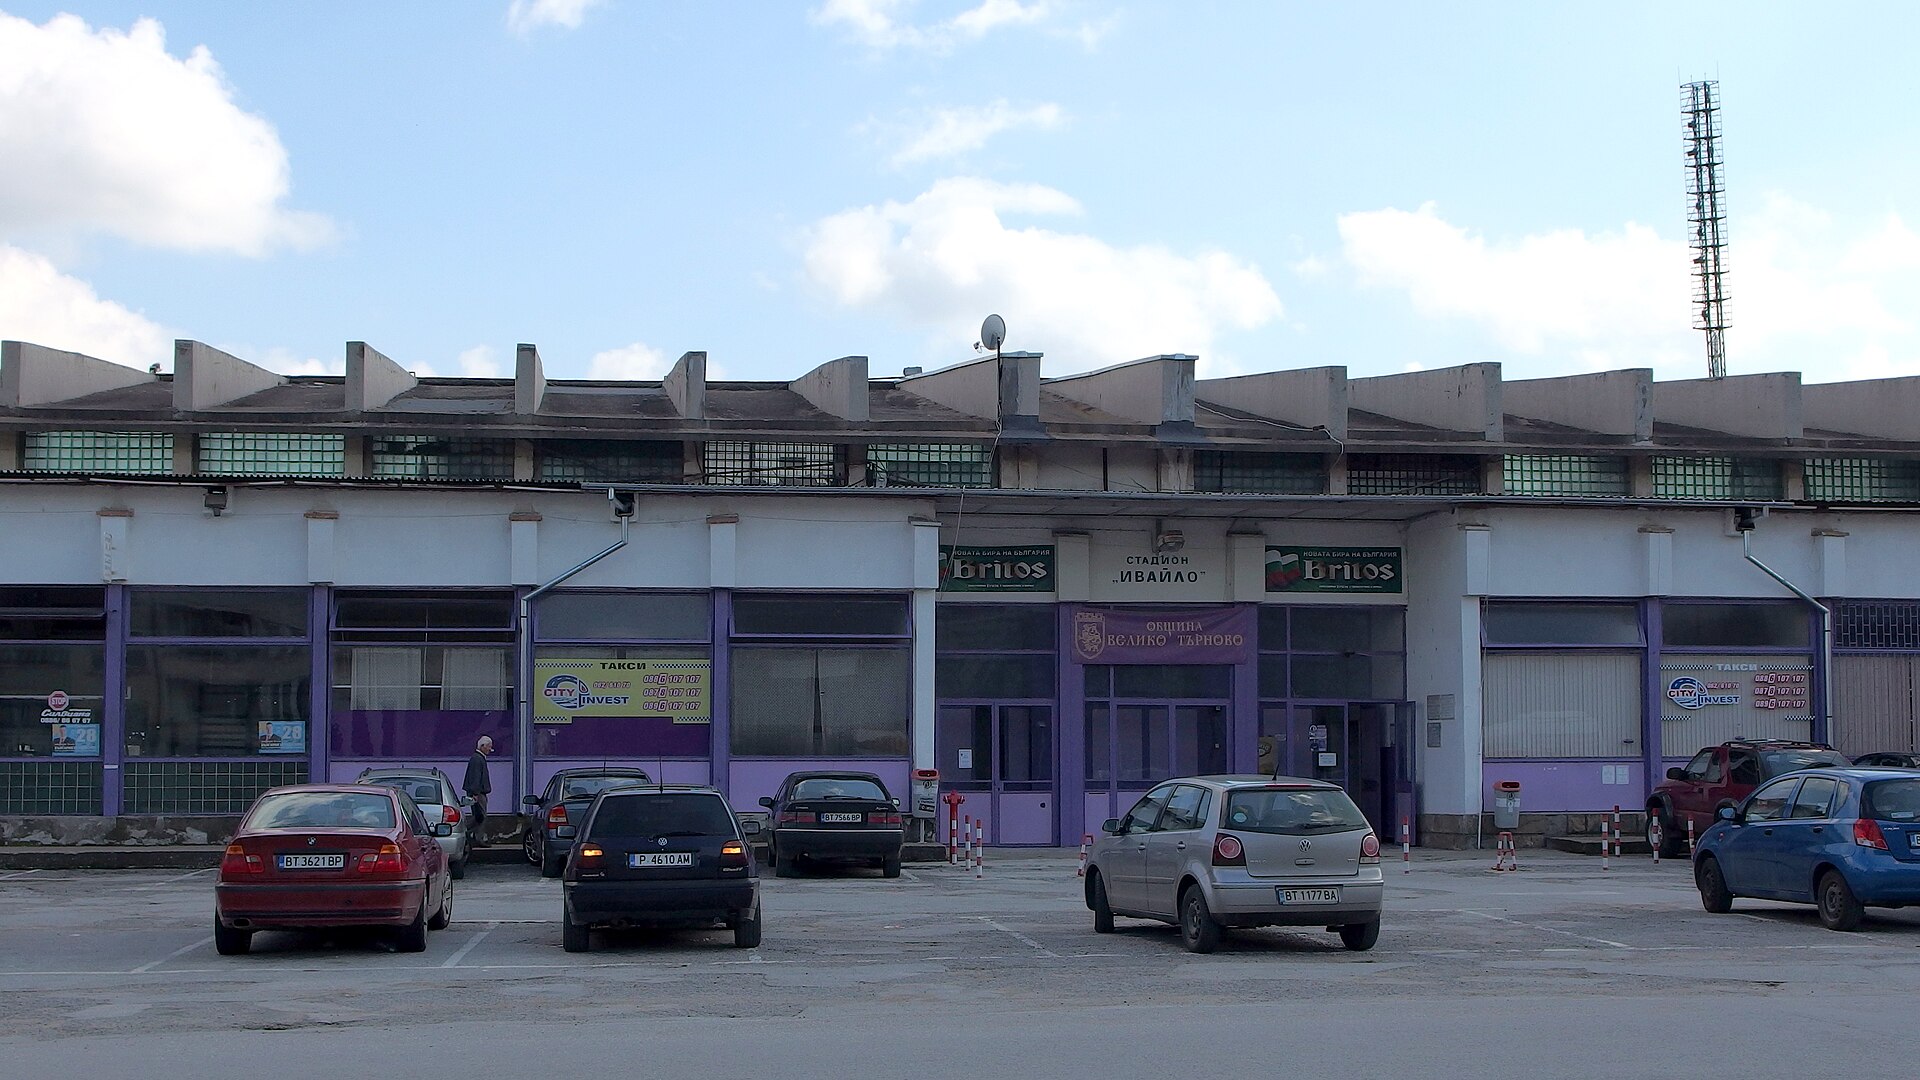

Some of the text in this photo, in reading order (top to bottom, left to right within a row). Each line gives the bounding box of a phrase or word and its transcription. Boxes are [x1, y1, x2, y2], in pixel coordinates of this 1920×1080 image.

[1126, 555, 1189, 565] СТАДИОН
[953, 559, 1047, 579] Britos
[1303, 559, 1395, 580] Britos
[1146, 621, 1203, 636] ОБЩИНА
[1107, 634, 1243, 646] ВЕЛИКО ТЪРНОВО
[599, 662, 647, 670] ТАКСИ
[1716, 663, 1758, 671] ТАКСИ
[668, 675, 684, 683] 107
[685, 675, 701, 683] 107
[544, 688, 575, 697] CITY
[668, 688, 684, 697] 107
[685, 688, 701, 697] 107
[1668, 690, 1697, 698] CITY
[1777, 687, 1790, 695] 107
[1792, 687, 1805, 695] 107
[51, 697, 66, 705] STOP
[582, 696, 630, 704] INVEST
[1701, 696, 1740, 704] INVEST
[1777, 700, 1790, 708] 107
[1792, 700, 1805, 708] 107
[668, 702, 684, 710] 107
[685, 702, 701, 710] 107
[76, 728, 97, 742] 28
[282, 726, 302, 739] 28
[285, 856, 342, 866] BT 3621 BP
[639, 854, 690, 864] P 4610 AM
[1285, 890, 1337, 901] BT 1177 BA
